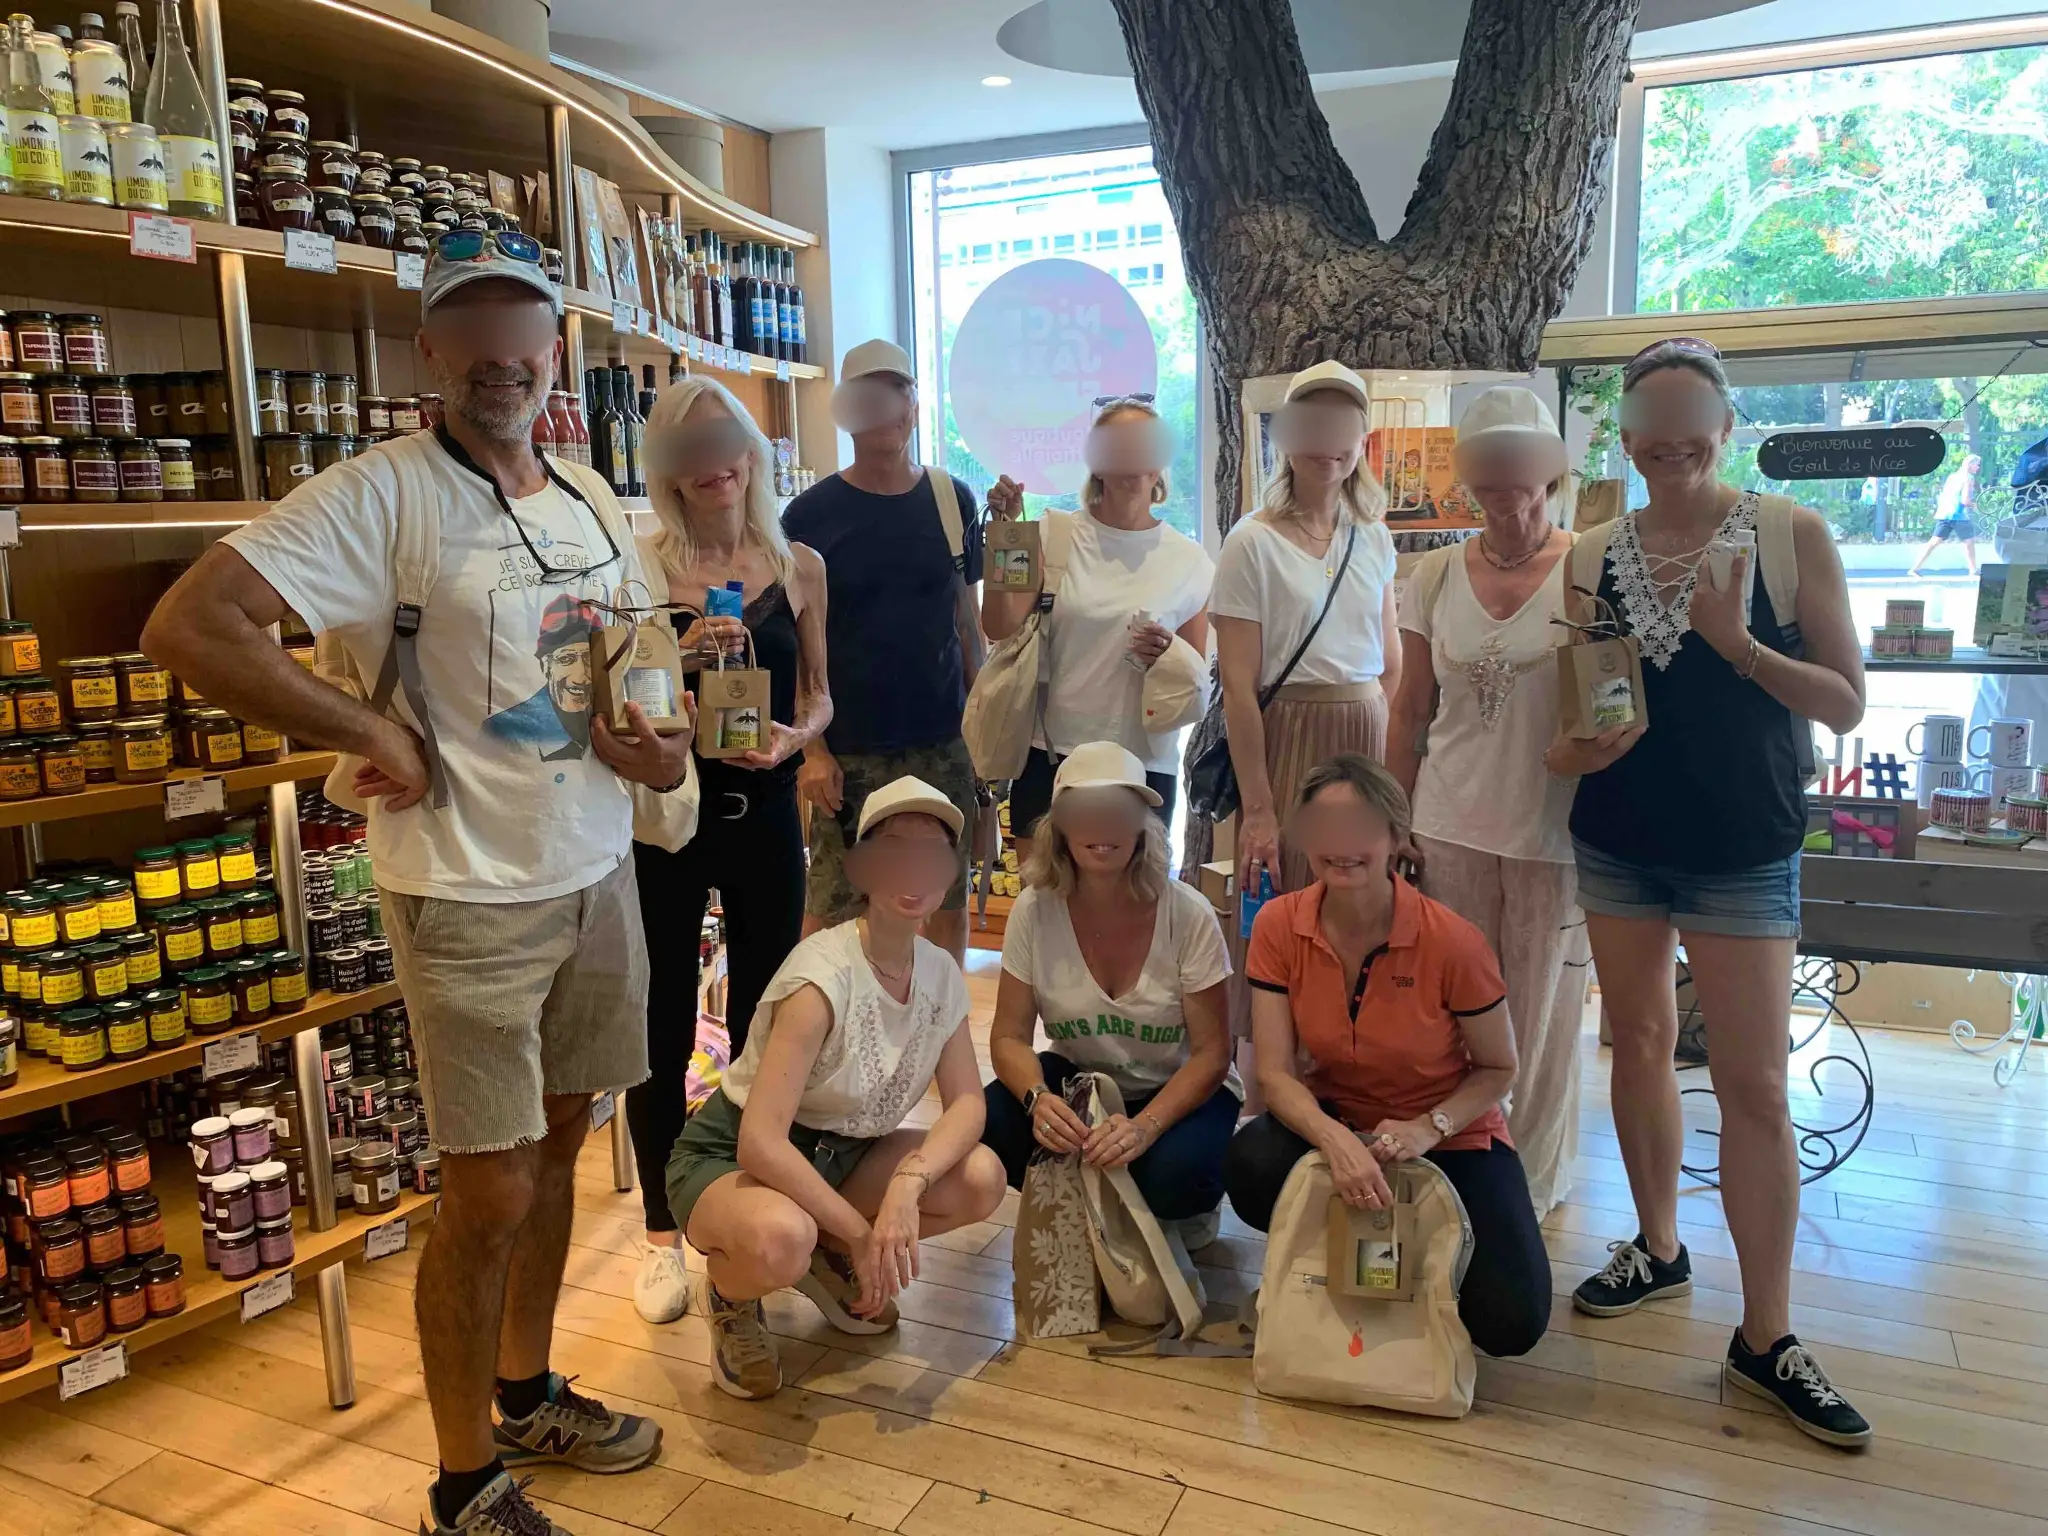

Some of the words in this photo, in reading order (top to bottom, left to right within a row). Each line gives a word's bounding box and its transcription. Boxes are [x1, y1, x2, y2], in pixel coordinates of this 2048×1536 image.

[16, 150, 28, 164] DU
[1779, 435, 1873, 456] Bienvenue
[1884, 437, 1917, 449] au
[1838, 460, 1862, 473] de
[1869, 454, 1907, 472] Nice
[500, 558, 514, 574] JE
[519, 554, 548, 570] SUS
[498, 575, 520, 592] CE
[338, 969, 353, 978] Huile
[1096, 1014, 1136, 1039] ARE
[532, 1423, 582, 1457] N
[480, 1486, 498, 1504] 574
